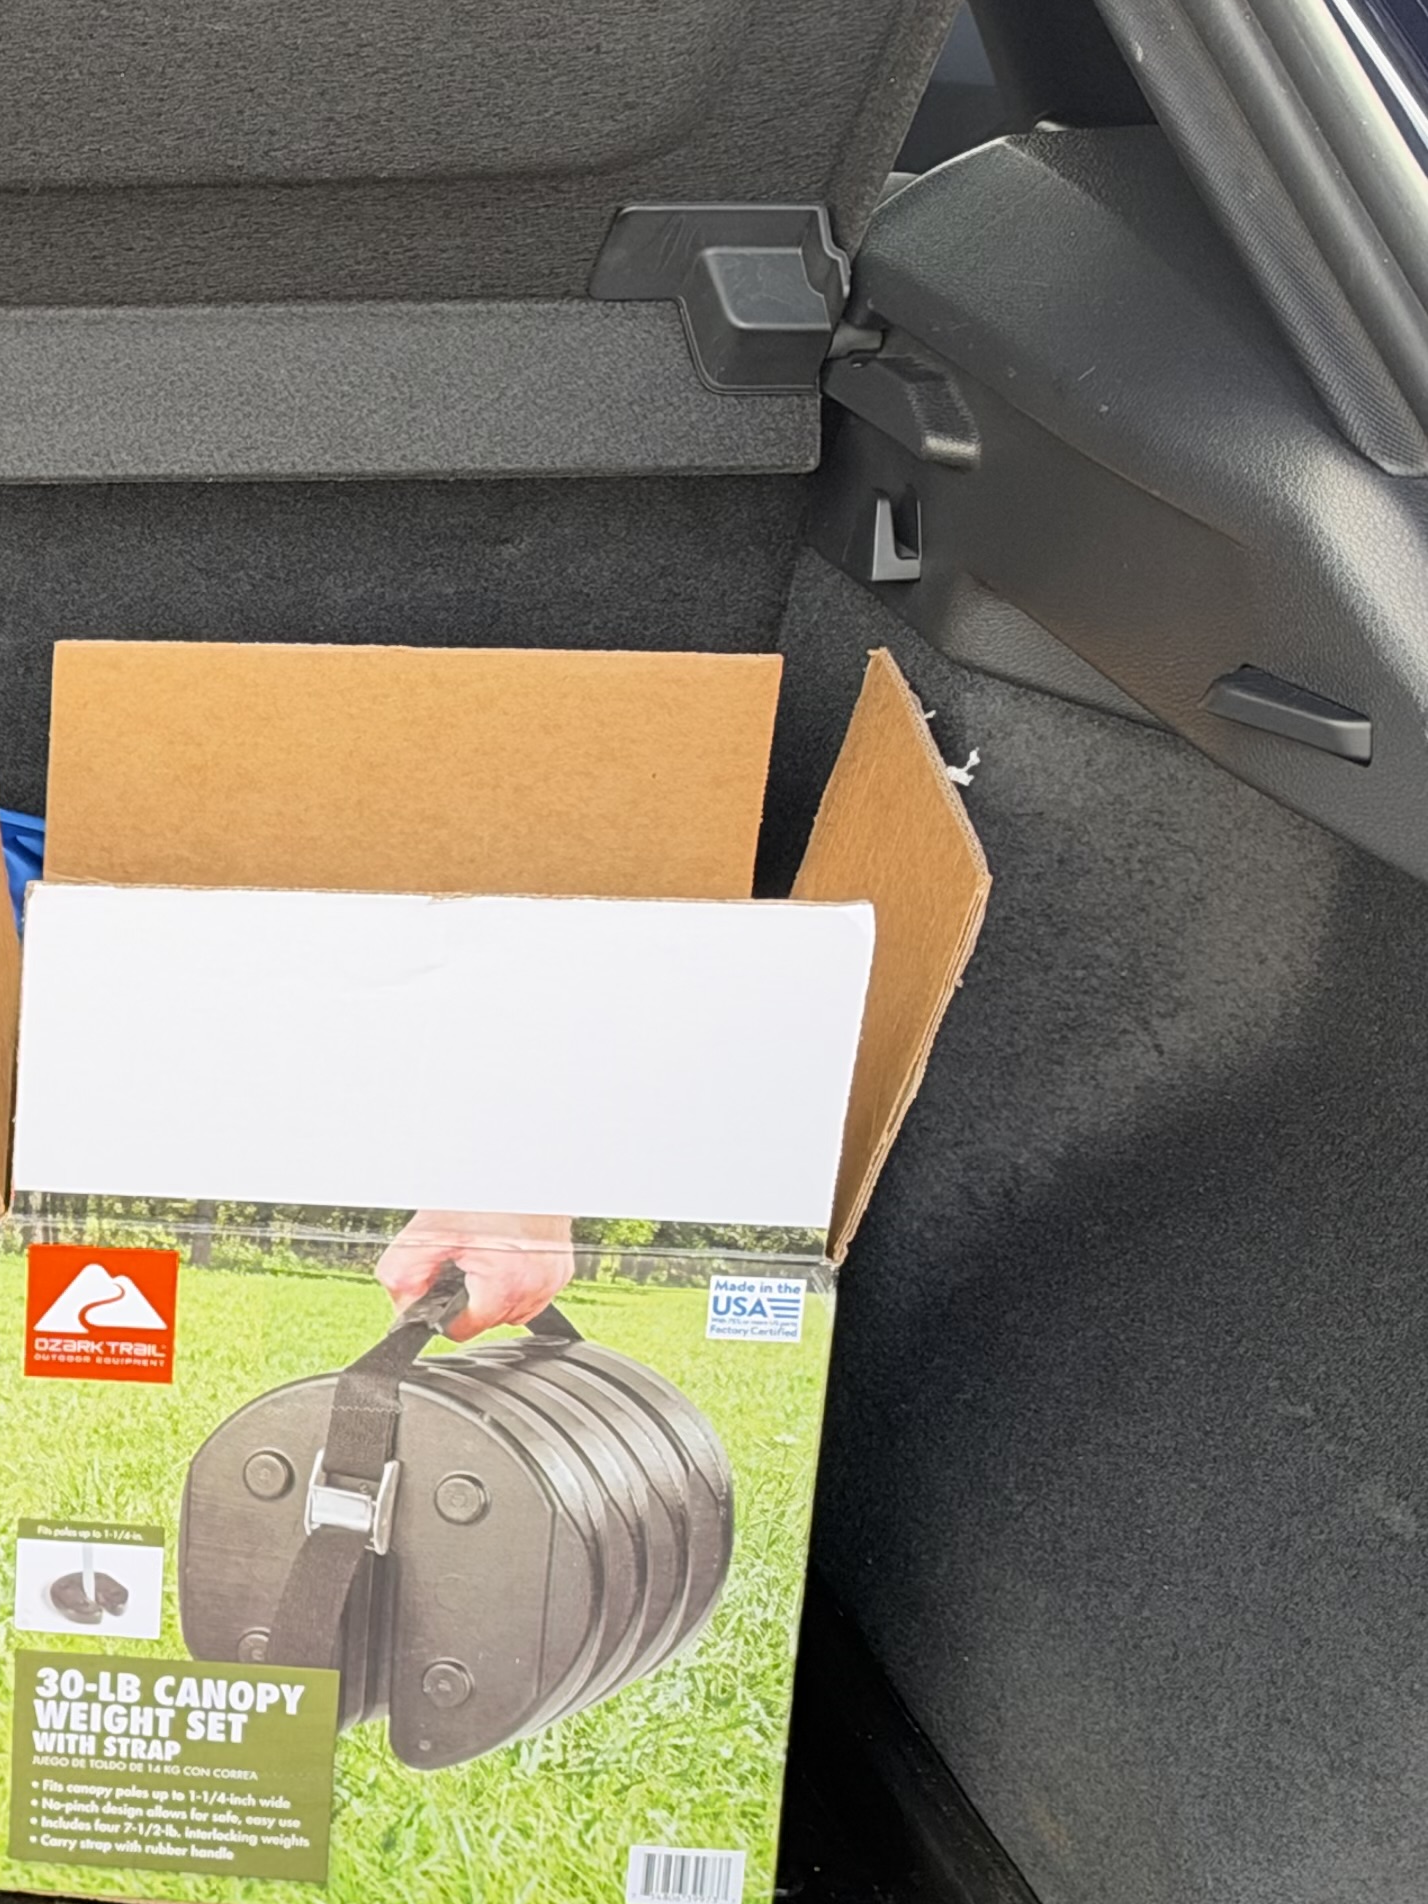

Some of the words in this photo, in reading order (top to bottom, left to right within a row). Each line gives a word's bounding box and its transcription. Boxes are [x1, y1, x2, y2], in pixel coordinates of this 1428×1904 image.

[715, 1280, 755, 1292] Made
[760, 1282, 772, 1293] in
[777, 1283, 801, 1294] the
[713, 1296, 767, 1318] USA
[710, 1325, 749, 1336] Factory
[750, 1327, 797, 1336] Certified
[33, 1354, 91, 1363] OUTDOOR
[96, 1357, 165, 1367] EQUIPMENT
[37, 1525, 52, 1536] Fits
[53, 1526, 77, 1537] poles
[79, 1530, 91, 1539] up
[92, 1529, 102, 1539] to
[35, 1667, 141, 1704] 30-LB
[153, 1675, 305, 1716] CANOPY
[33, 1699, 176, 1738] WEIGHT
[186, 1710, 249, 1743] SET
[32, 1730, 96, 1757] WITH
[103, 1736, 182, 1762] STRAP
[32, 1756, 69, 1767] JUEGO
[72, 1759, 86, 1768] DE
[89, 1760, 126, 1771] TOLDO
[129, 1763, 143, 1772] DE
[148, 1764, 161, 1773] 14
[164, 1765, 181, 1775] KG
[183, 1766, 210, 1777] CON
[213, 1768, 258, 1781] CORREA
[42, 1779, 64, 1793] Fits
[66, 1783, 113, 1798] canopy
[115, 1785, 149, 1799] poles
[152, 1790, 169, 1802] up
[172, 1790, 185, 1802] to
[189, 1790, 256, 1807] 1-1/4-inch
[259, 1795, 291, 1809] wide
[41, 1797, 99, 1814] No-pinch
[102, 1801, 143, 1819] design
[146, 1805, 187, 1820] allows
[190, 1807, 209, 1822] for
[211, 1810, 242, 1826] safe,
[245, 1816, 276, 1830] easy
[278, 1818, 301, 1829] use
[41, 1815, 92, 1831] Includes
[95, 1818, 121, 1833] four
[123, 1822, 181, 1839] 7-1/2-lb.
[185, 1826, 258, 1847] interlocking
[261, 1833, 310, 1849] weights
[40, 1833, 77, 1851] Carry
[79, 1838, 113, 1853] strap
[114, 1839, 142, 1853] with
[144, 1841, 188, 1857] rubber
[190, 1844, 234, 1860] handle
